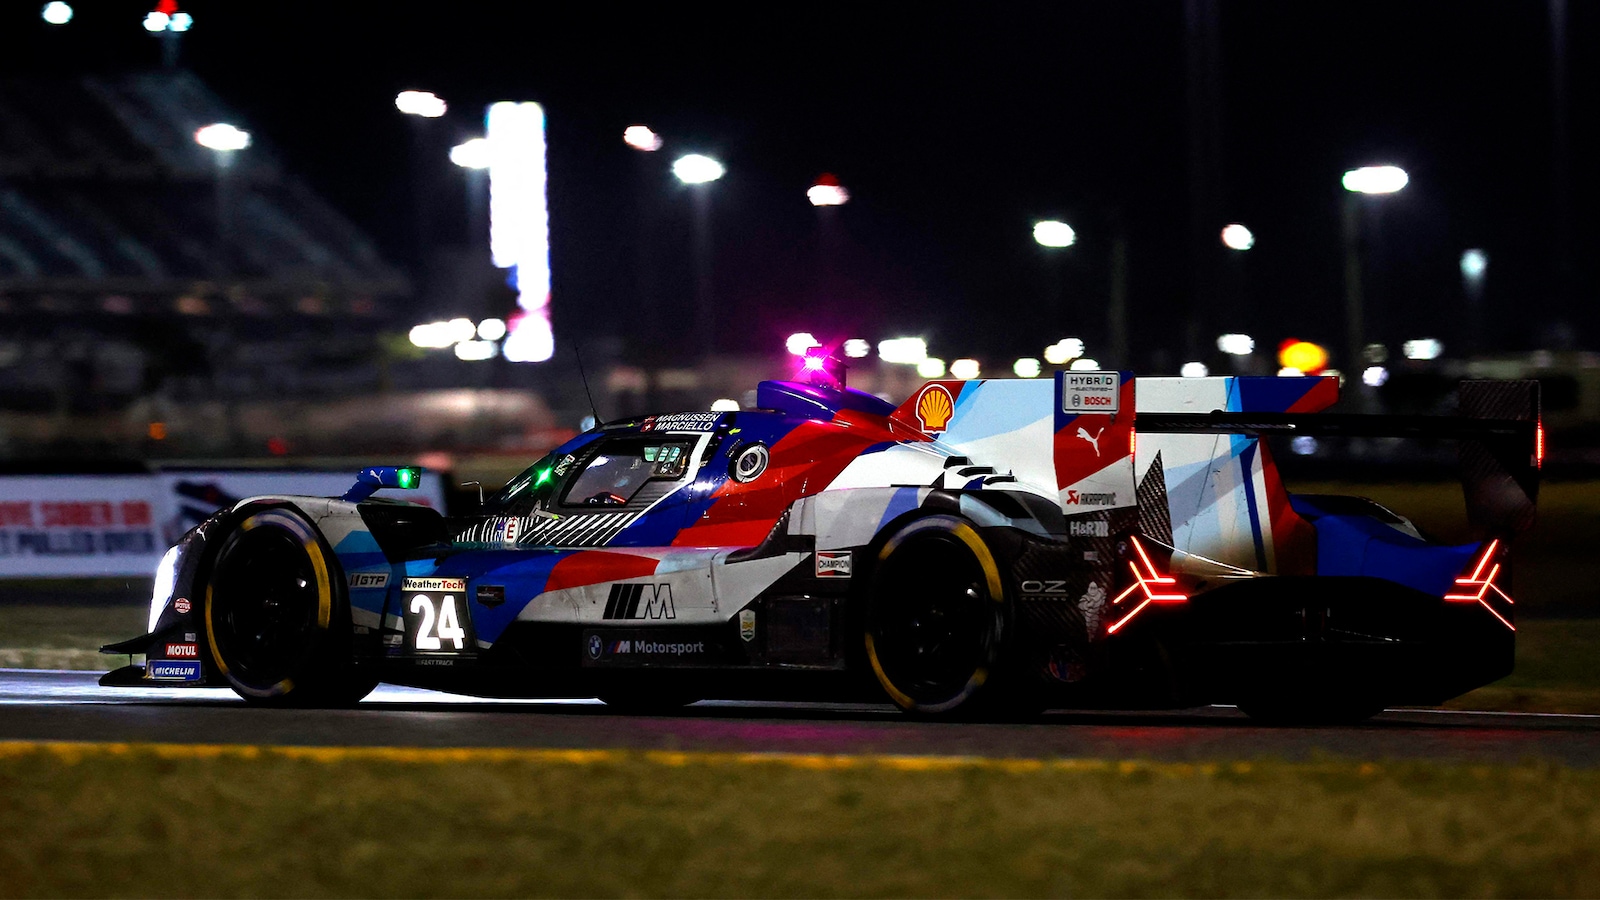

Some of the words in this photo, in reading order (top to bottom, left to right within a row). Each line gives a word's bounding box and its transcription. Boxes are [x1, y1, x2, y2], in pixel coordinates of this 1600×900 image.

[1084, 396, 1112, 405] BOSCH
[655, 413, 721, 423] MAGNUSSEN
[653, 421, 714, 431] MARCIELLO
[1070, 521, 1095, 536] H&R
[818, 560, 849, 569] CHAMPION
[360, 576, 385, 585] GTP
[404, 579, 464, 589] WeatherTech
[1021, 580, 1067, 593] OZ
[410, 594, 465, 650] 24
[167, 645, 197, 656] MOTUL
[634, 640, 704, 656] Motorsport
[155, 667, 195, 676] MICHELIN
